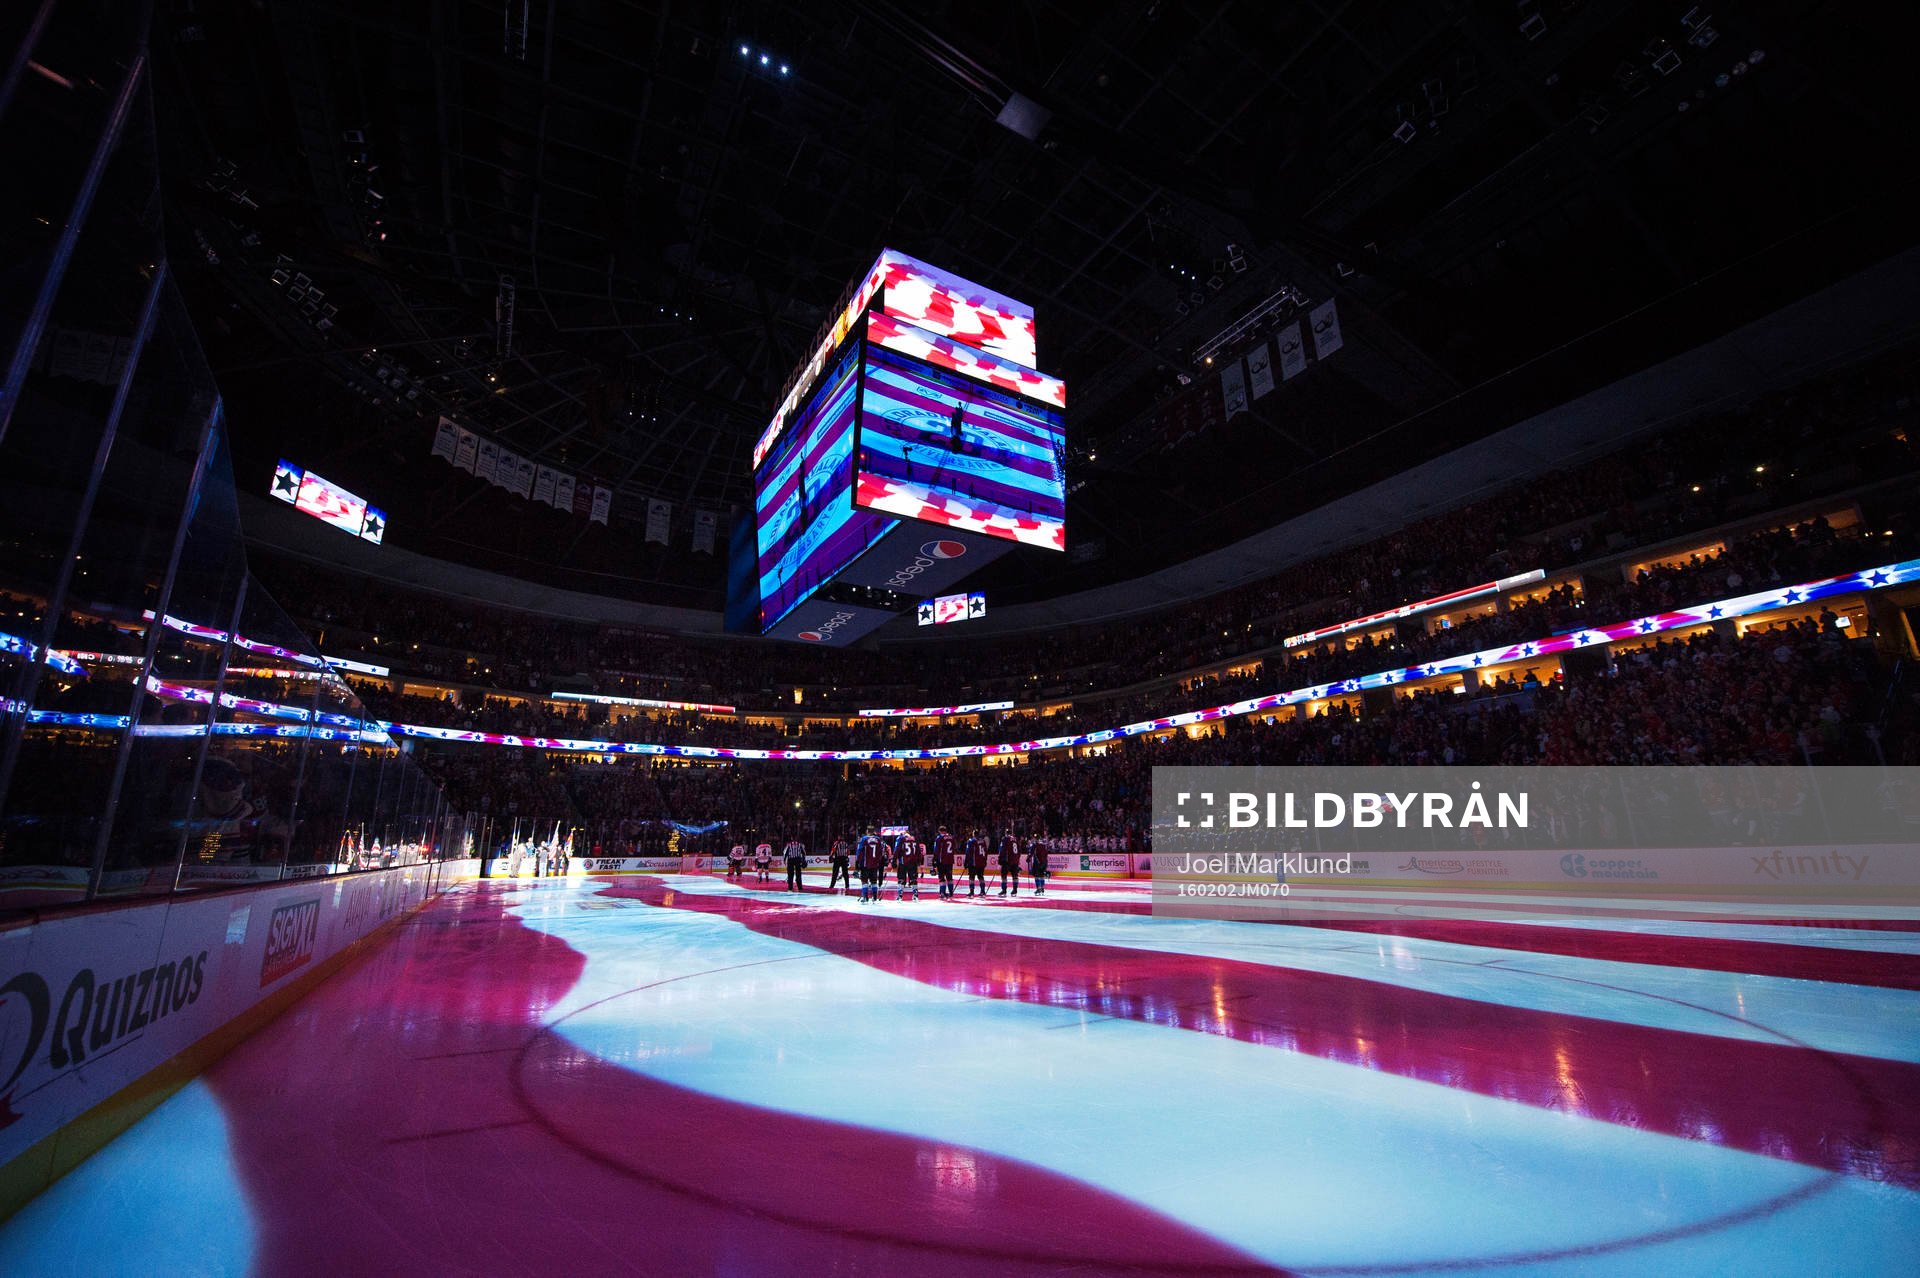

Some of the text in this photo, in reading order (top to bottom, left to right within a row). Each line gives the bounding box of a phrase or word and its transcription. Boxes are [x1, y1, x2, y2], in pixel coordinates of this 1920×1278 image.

[883, 556, 934, 587] pepsi
[818, 611, 856, 634] pepsi
[869, 844, 876, 858] 7
[946, 841, 953, 854] 2
[978, 845, 985, 856] 4
[1012, 842, 1018, 854] 8
[1082, 858, 1125, 869] enterprise
[1588, 859, 1642, 870] copper
[1750, 849, 1870, 881] xfinity
[1591, 867, 1659, 879] mountain
